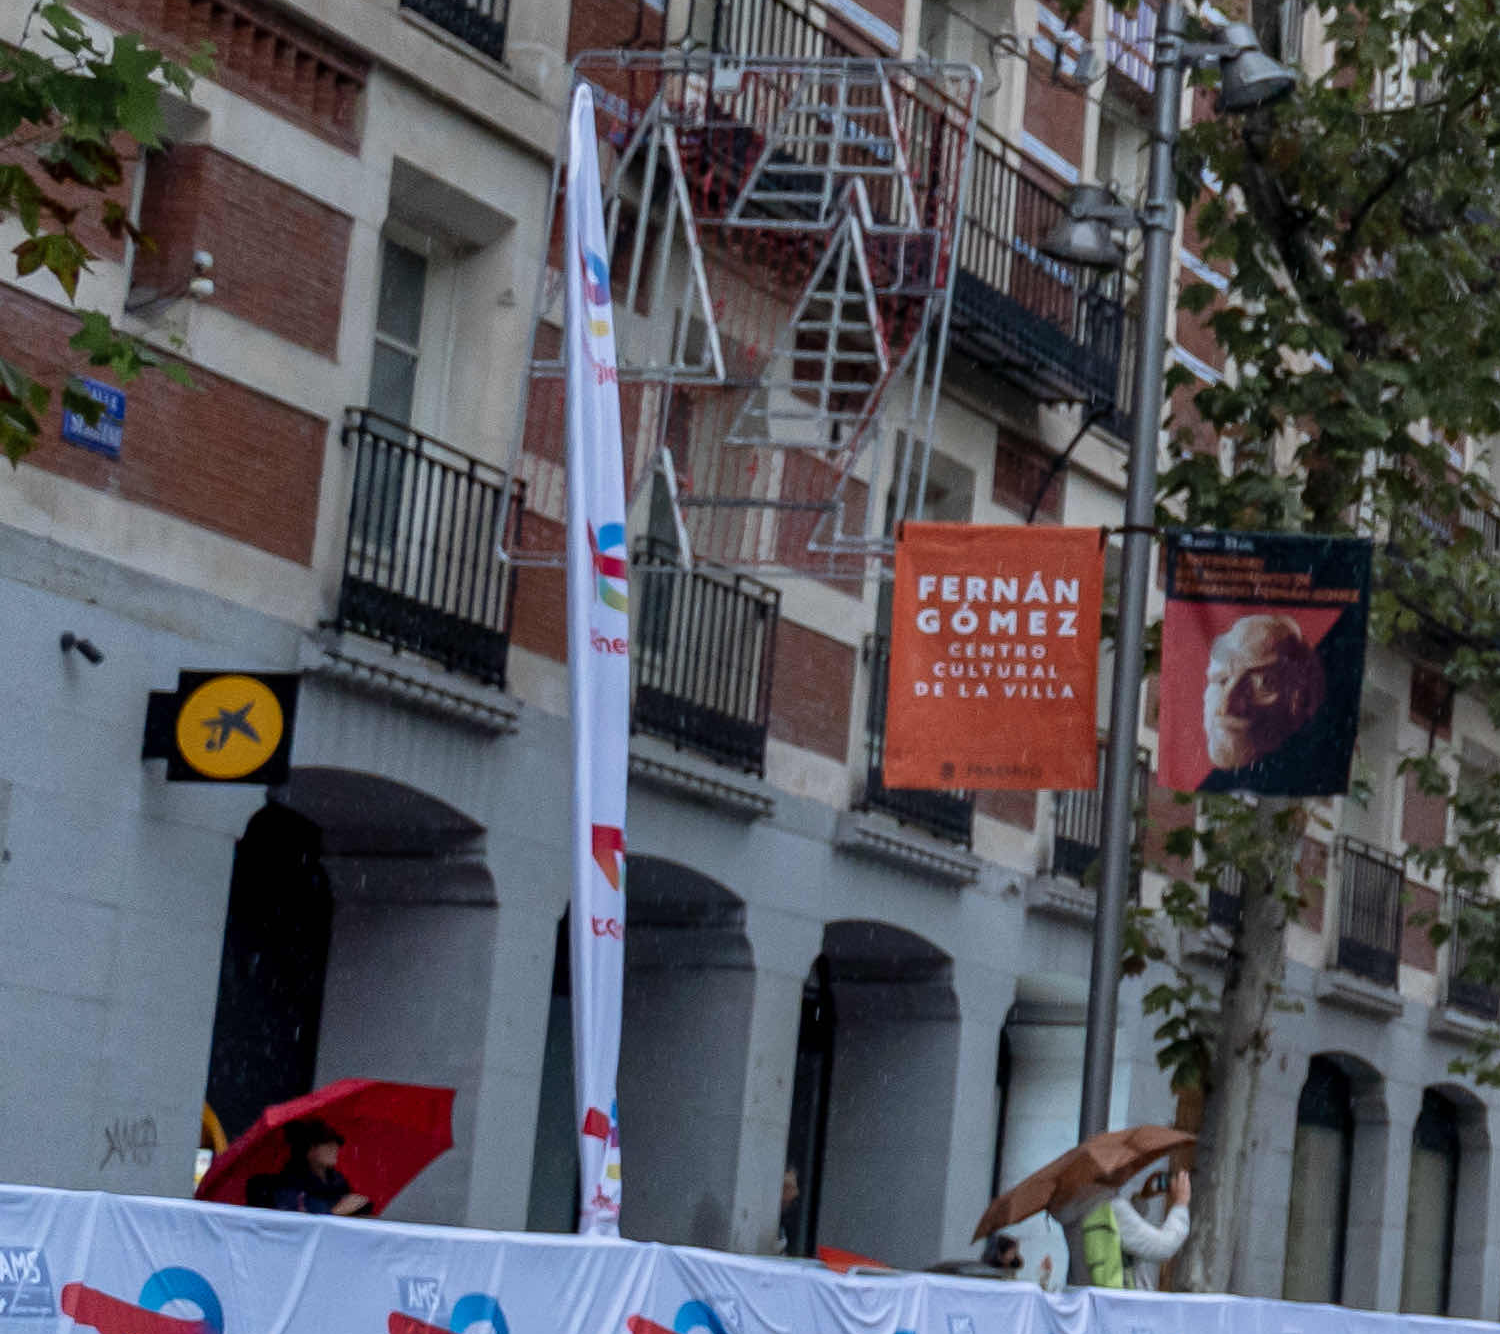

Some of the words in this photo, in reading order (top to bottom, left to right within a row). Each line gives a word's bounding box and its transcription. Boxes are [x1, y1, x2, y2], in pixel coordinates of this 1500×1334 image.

[917, 571, 1080, 604] FERNÁN
[916, 602, 1078, 636] GÓMEZ
[948, 642, 1047, 659] CENTRO
[933, 661, 1058, 679] CULTURAL
[914, 681, 944, 698] DE
[959, 683, 989, 698] LA
[1004, 683, 1074, 699] VILLA
